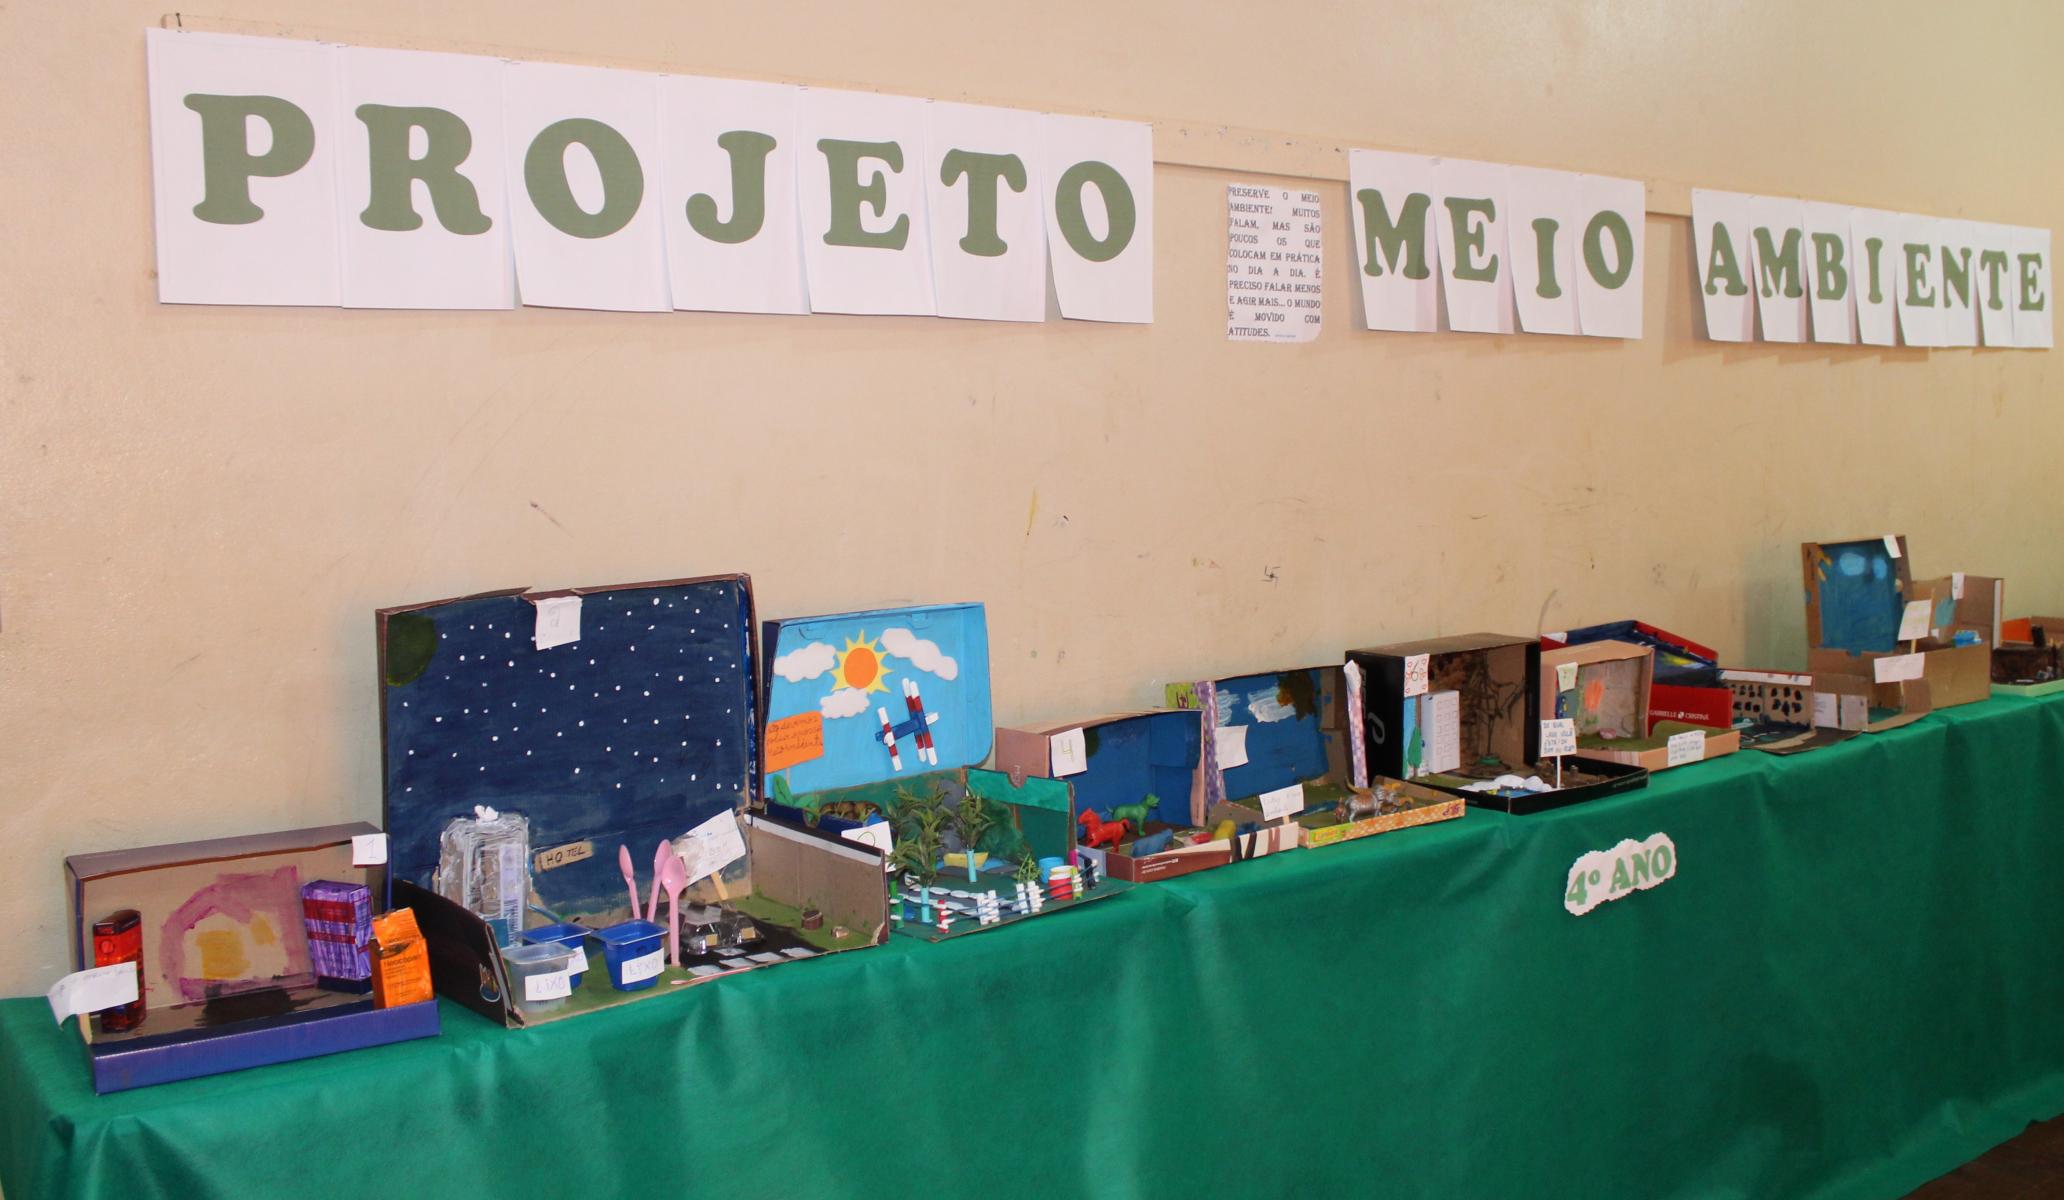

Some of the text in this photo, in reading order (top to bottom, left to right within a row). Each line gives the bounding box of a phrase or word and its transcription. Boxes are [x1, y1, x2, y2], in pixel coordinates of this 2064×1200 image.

[1228, 186, 1320, 203] PRESERVE O MEIO
[183, 93, 2048, 313] PROJETO MEIO AMBIENTE
[1292, 207, 1320, 218] MUITOS
[1272, 222, 1291, 231] MAS
[1304, 222, 1320, 233] SÃO
[1230, 233, 1320, 249] POUCOS OS QUE
[1229, 249, 1320, 263] COLOCAM EM PRÁTICA
[1228, 265, 1321, 279] NO DIA A DIA. É
[1229, 280, 1320, 294] PRECISO FALAR MENOS
[1229, 296, 1235, 304] E
[1236, 296, 1256, 306] AGIR
[1287, 299, 1292, 307] O
[1295, 299, 1320, 309] MUNDO
[1255, 312, 1285, 322] MOVIDO
[1304, 315, 1320, 324] COM
[1228, 327, 1270, 337] ATITUDES.
[1609, 845, 1672, 893] ANO
